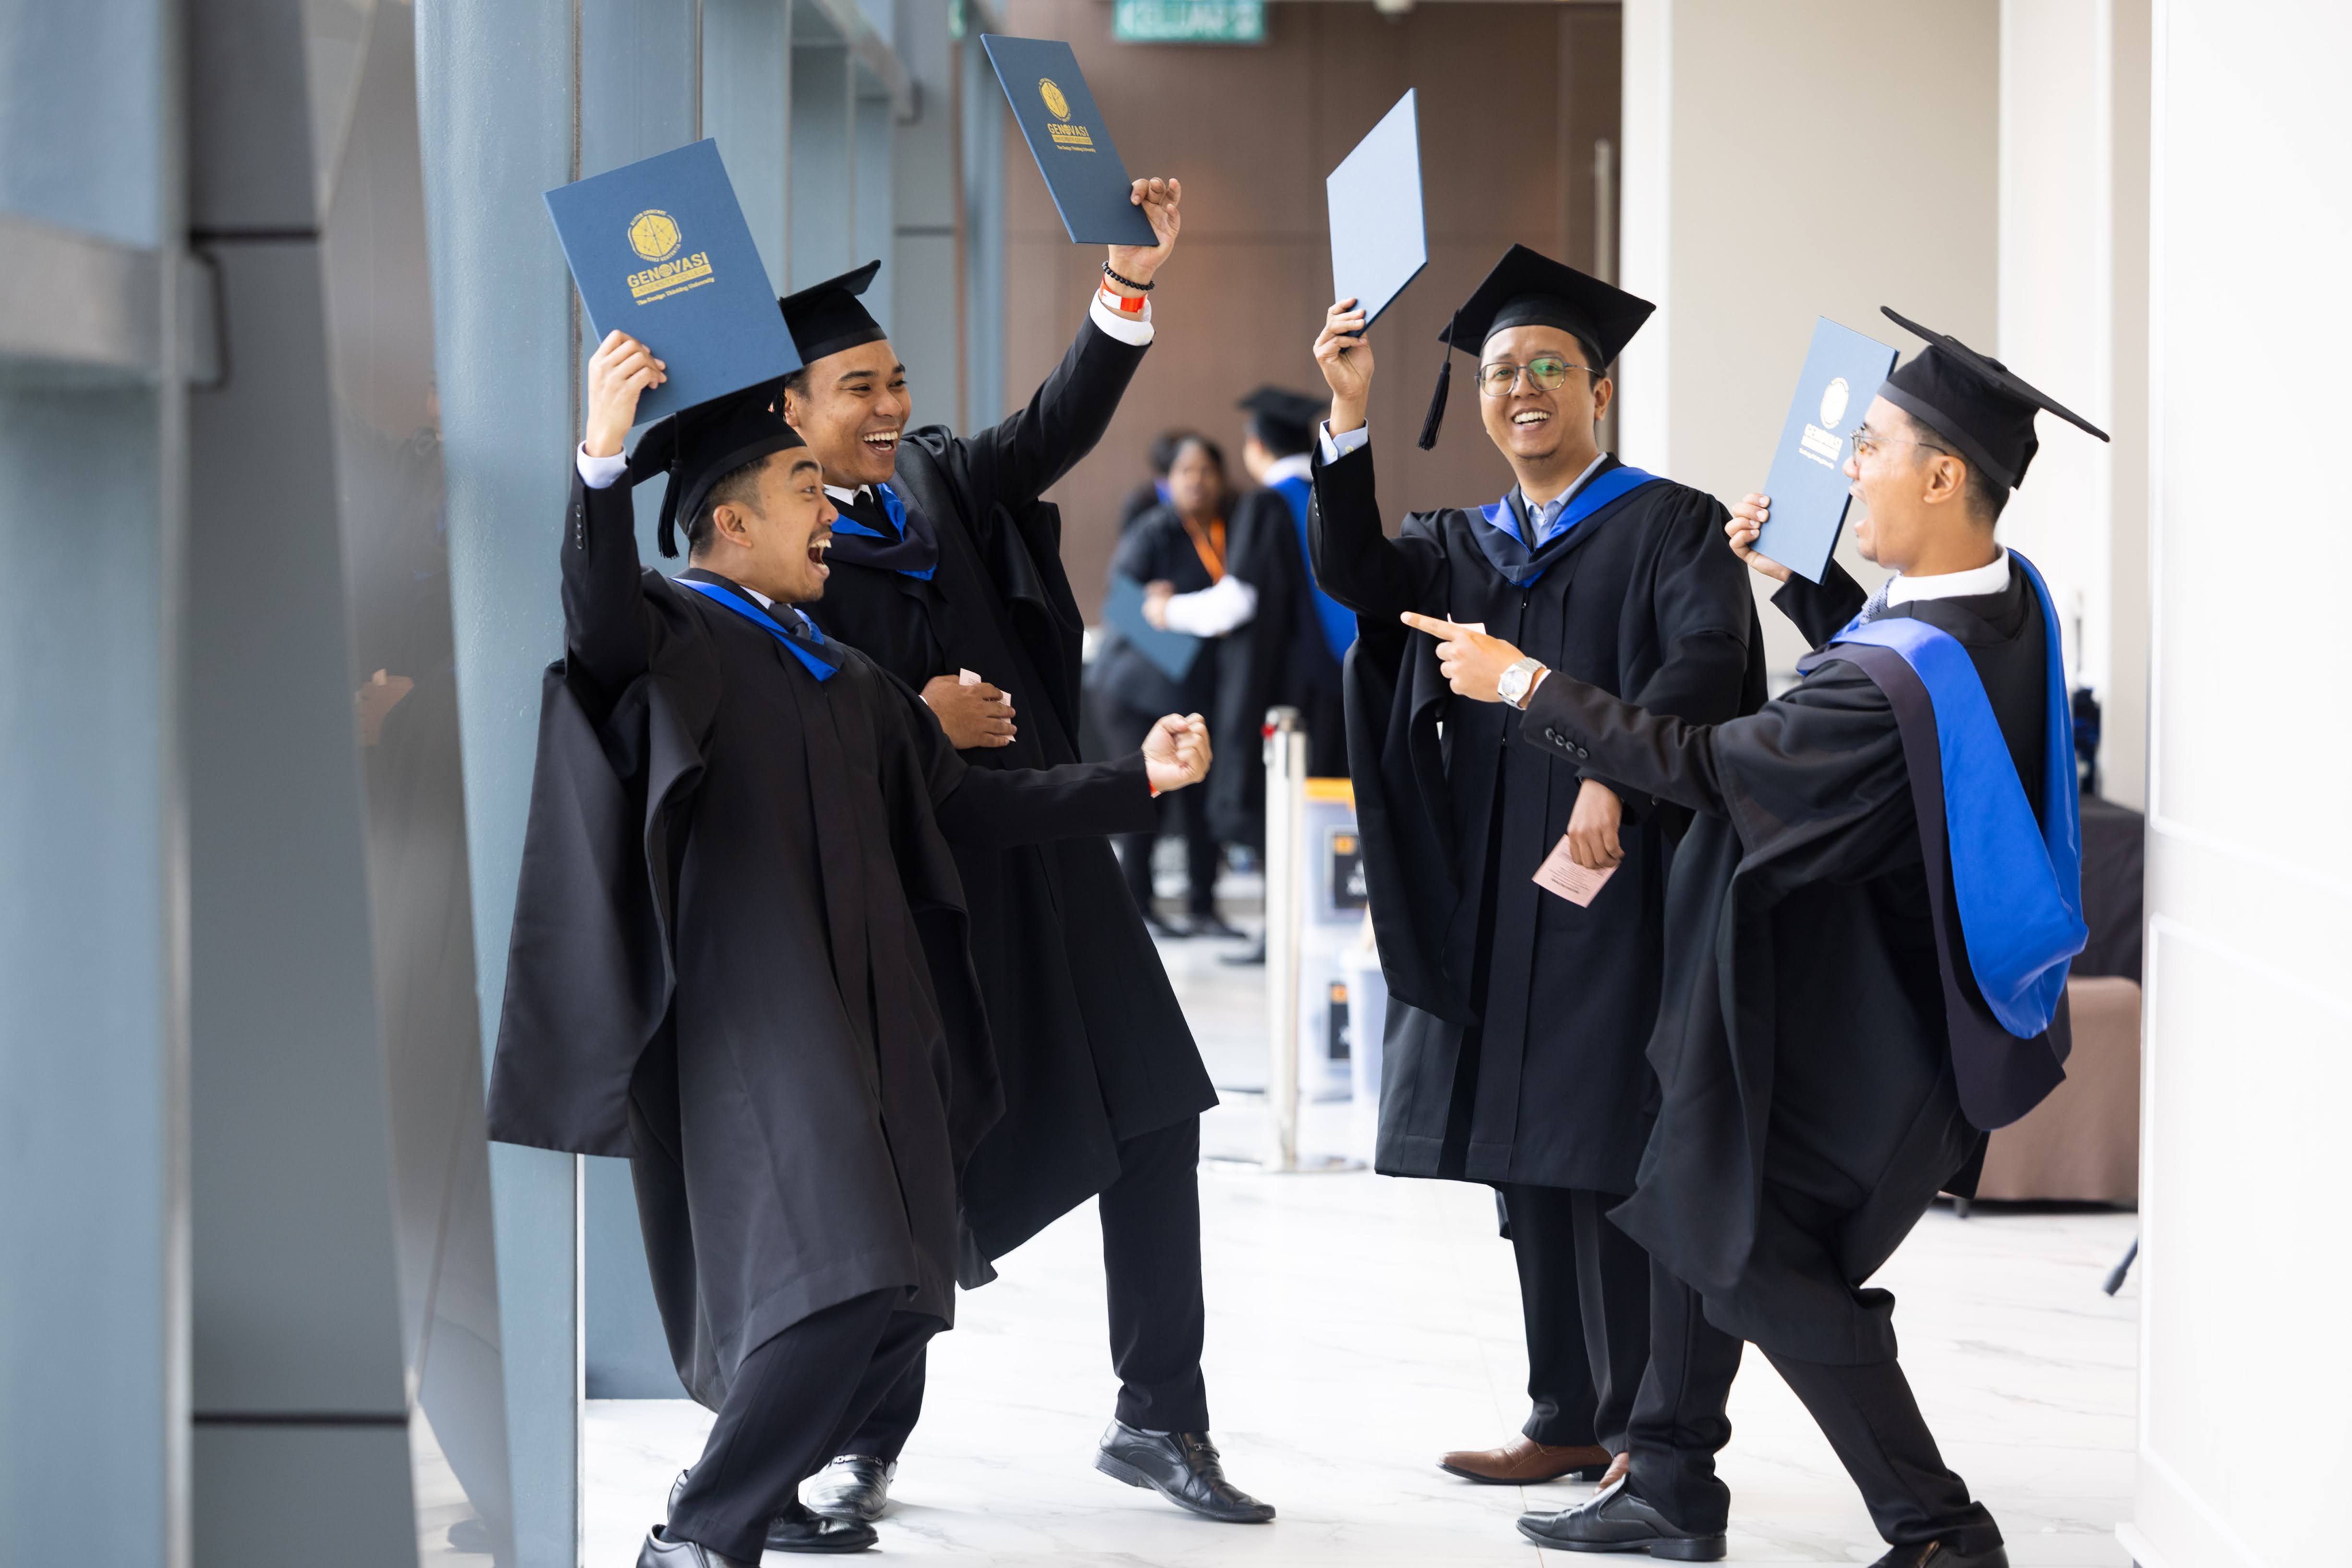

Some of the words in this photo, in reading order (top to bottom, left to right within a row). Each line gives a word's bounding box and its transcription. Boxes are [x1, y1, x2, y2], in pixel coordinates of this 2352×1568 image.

[1047, 123, 1089, 136] GENOVASI
[627, 251, 709, 288] GENOVASI
[633, 277, 675, 295] UNIVERSITY
[677, 267, 709, 281] COLLEGE
